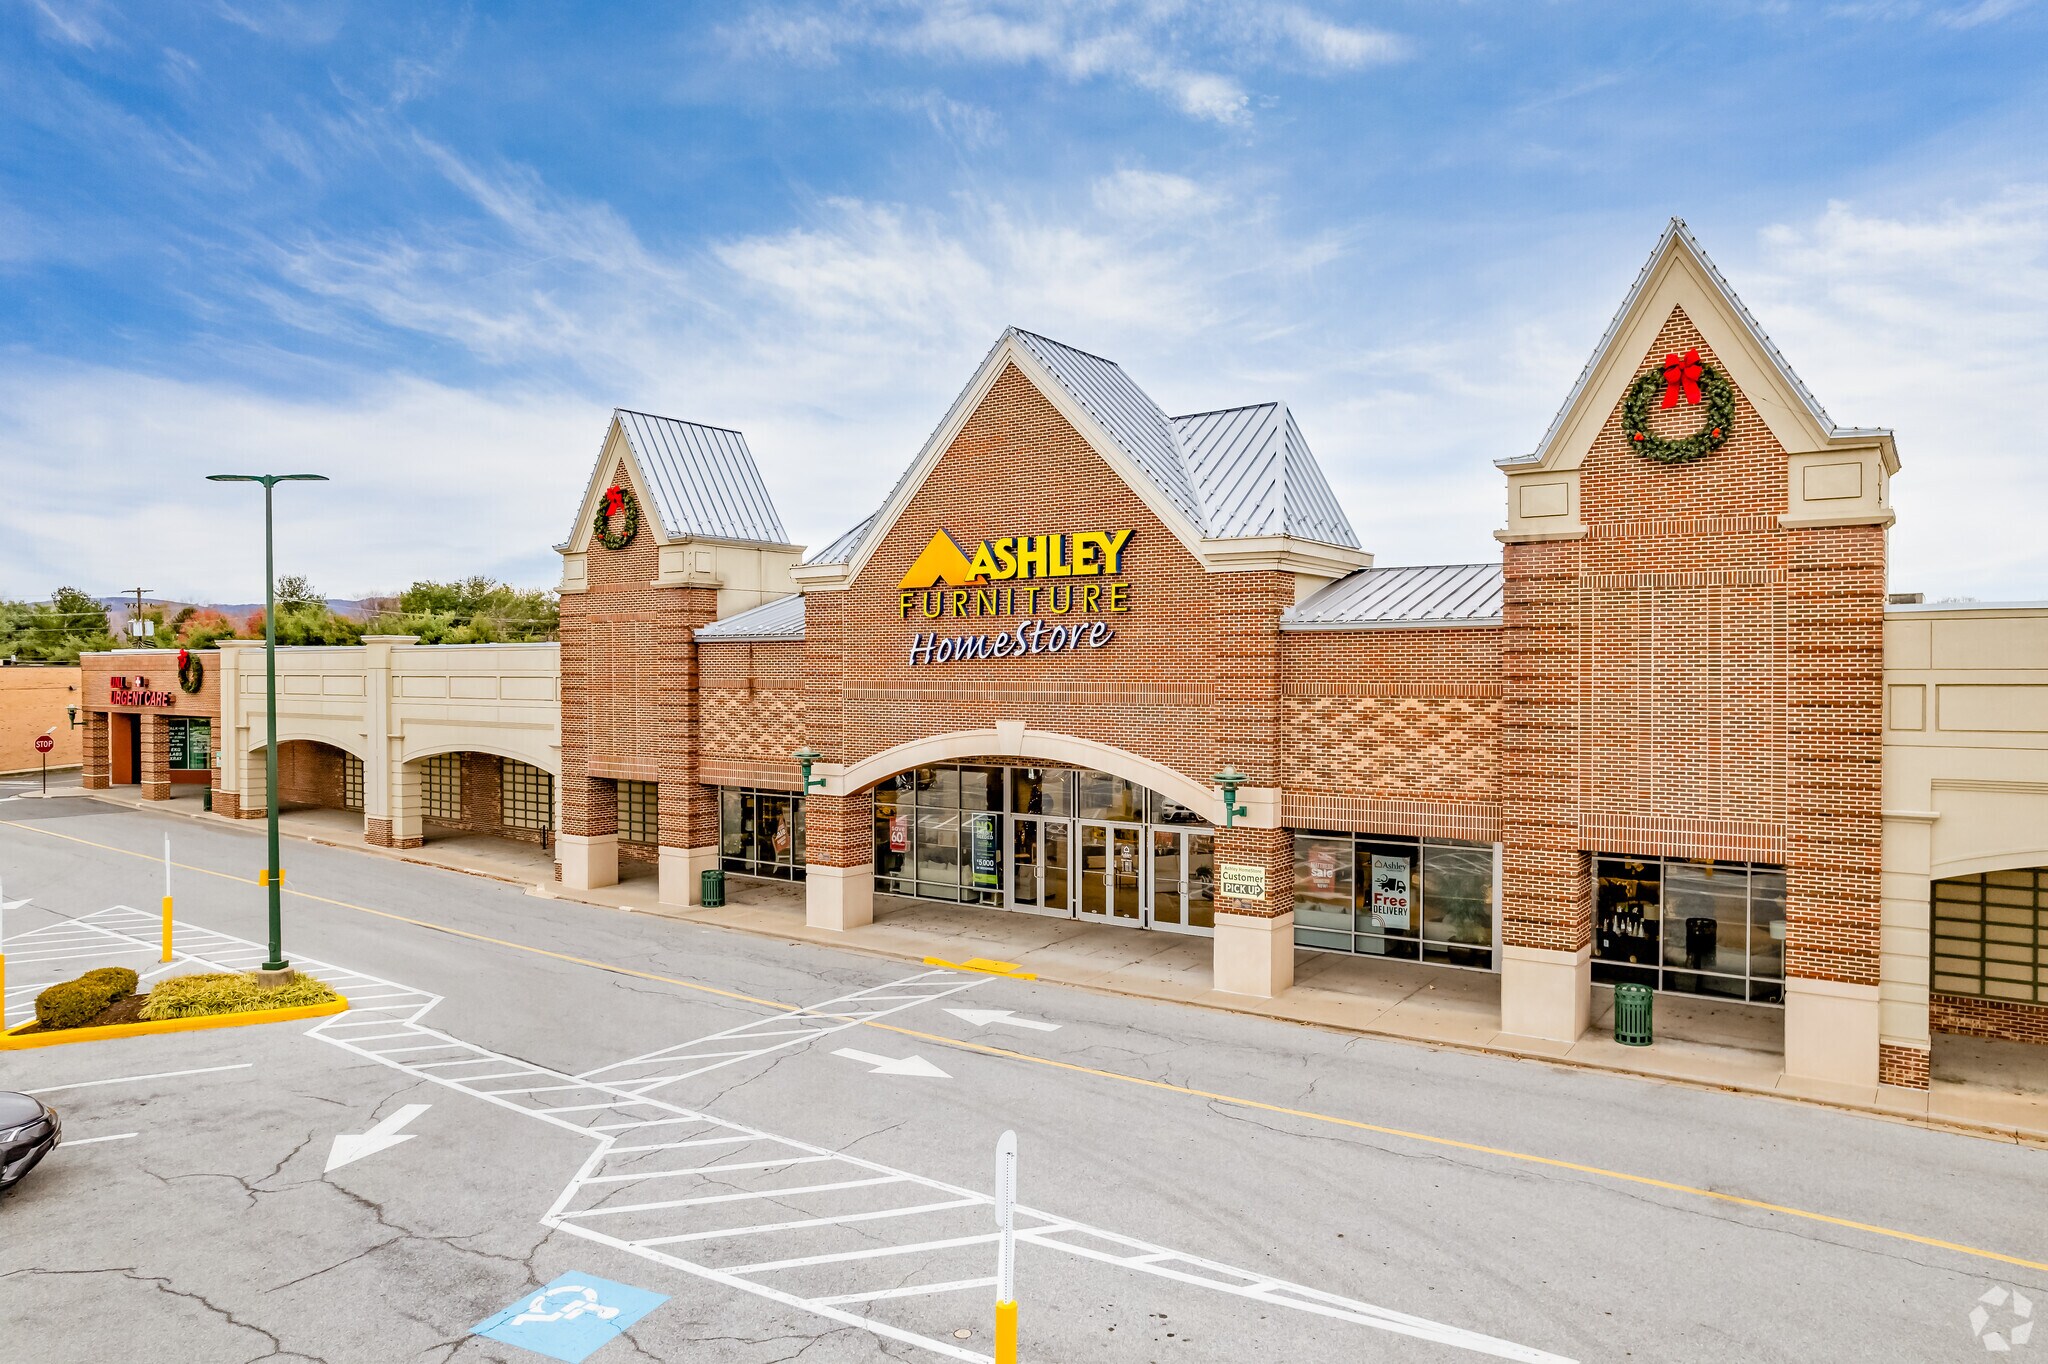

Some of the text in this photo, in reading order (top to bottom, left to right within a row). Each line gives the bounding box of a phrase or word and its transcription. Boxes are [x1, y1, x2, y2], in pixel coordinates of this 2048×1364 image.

[964, 528, 1133, 582] ASHLEY
[899, 583, 1131, 618] FURNITURE
[908, 619, 1114, 665] HomeStore
[110, 690, 168, 707] URGENT CARE
[36, 740, 53, 748] STOP
[1383, 861, 1407, 871] Ashley
[1222, 871, 1264, 883] Customer
[1225, 883, 1261, 895] PICK UP
[1373, 892, 1408, 908] Free
[1373, 904, 1408, 916] DELIVERY
